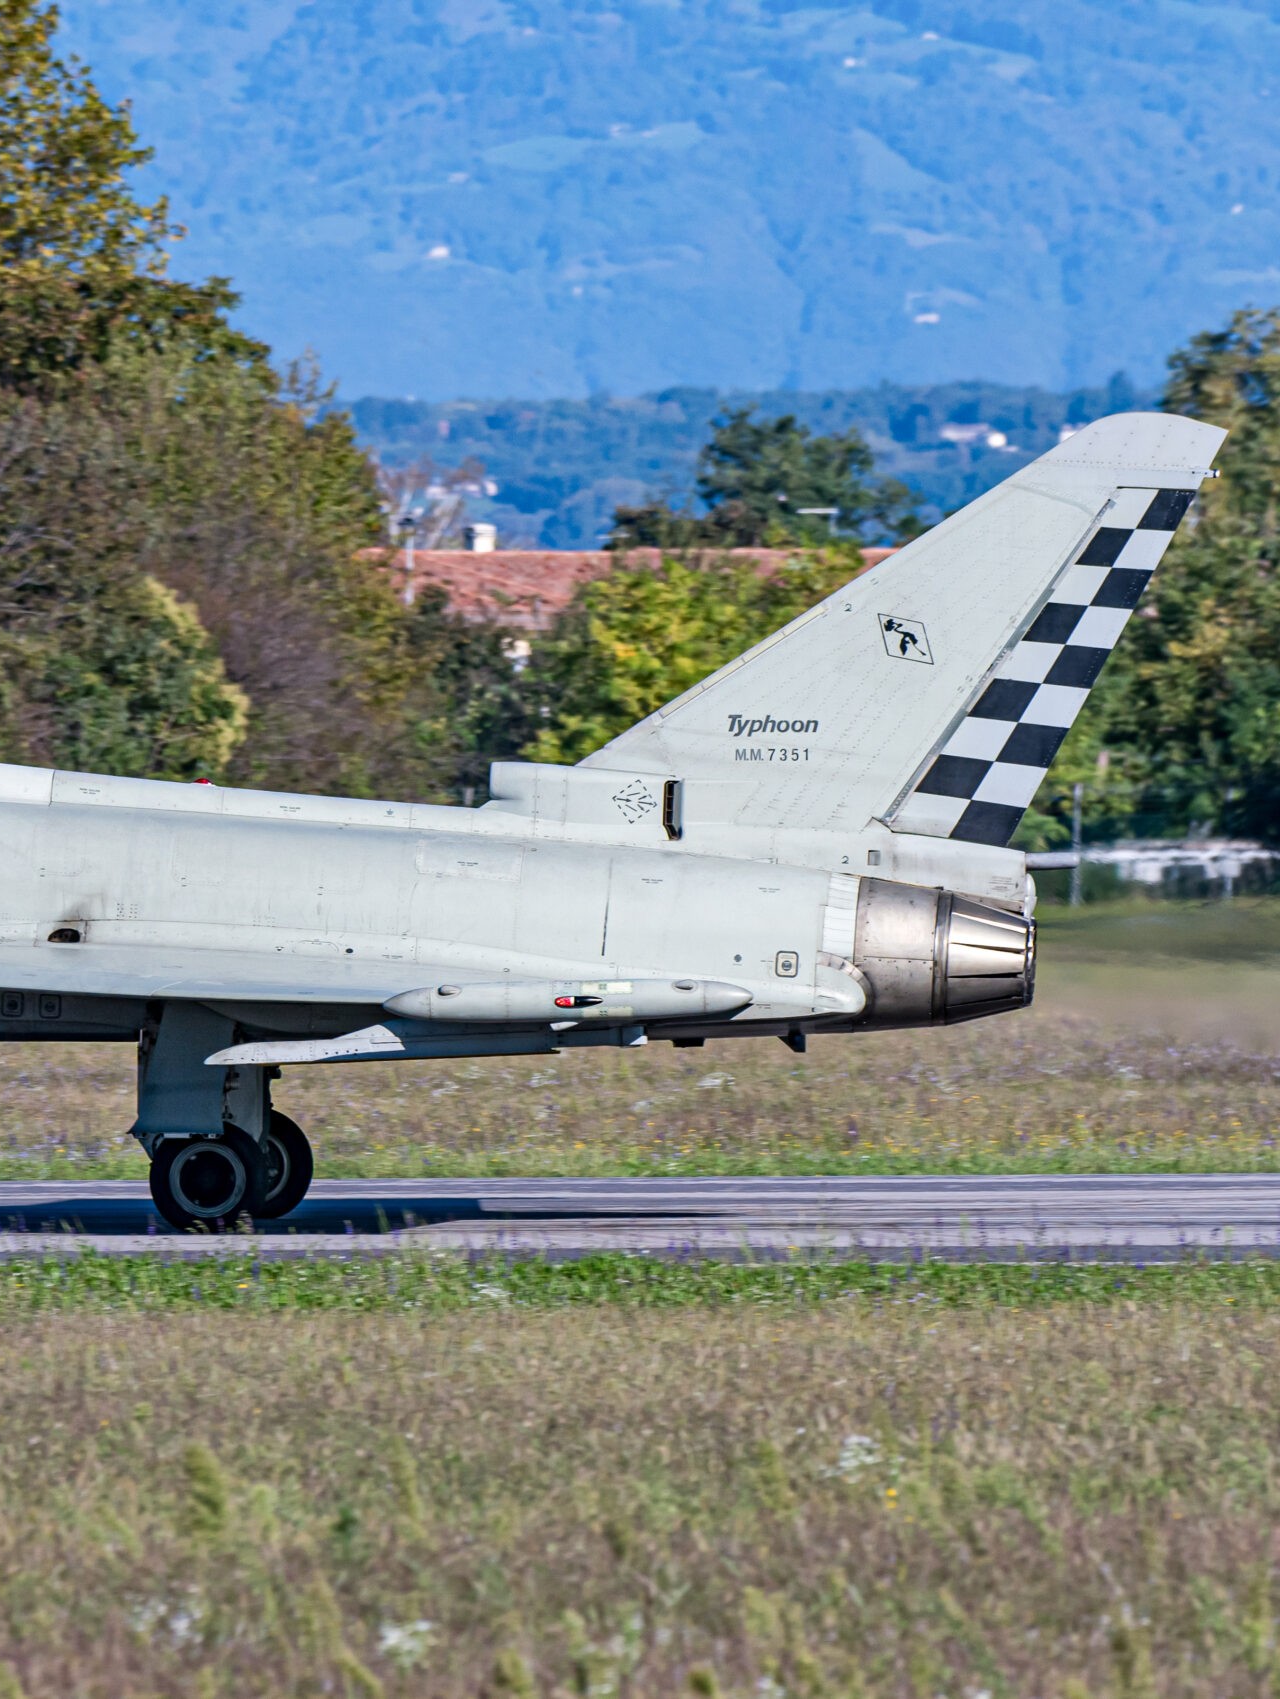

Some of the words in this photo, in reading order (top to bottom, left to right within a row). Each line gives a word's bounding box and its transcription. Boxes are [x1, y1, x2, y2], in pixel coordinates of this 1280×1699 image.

[844, 603, 852, 612] 2
[727, 714, 819, 737] Typhoon
[735, 748, 764, 761] M.M.
[767, 748, 809, 761] 7351
[841, 855, 849, 864] 2
